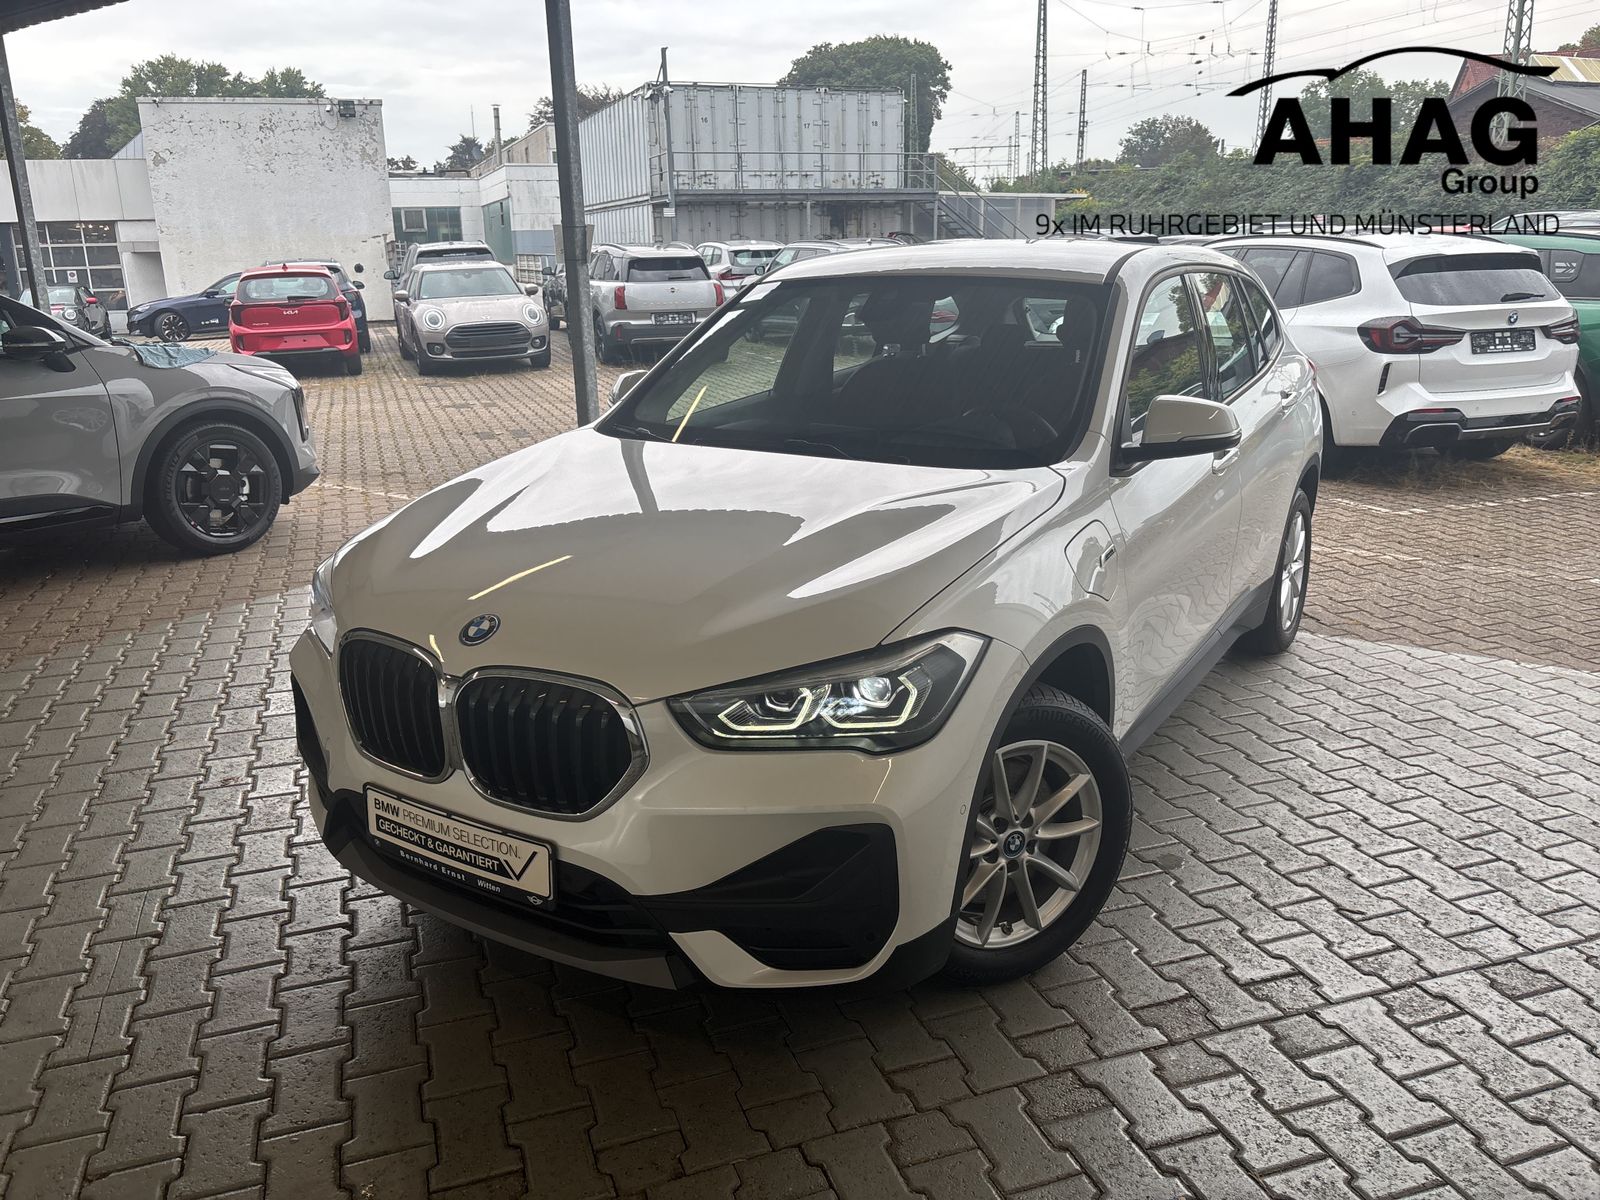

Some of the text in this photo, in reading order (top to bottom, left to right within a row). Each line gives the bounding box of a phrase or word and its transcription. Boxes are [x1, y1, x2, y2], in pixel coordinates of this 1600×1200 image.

[700, 116, 709, 124] 16
[374, 797, 521, 860] BMW PREMIUM SELECTION.
[378, 818, 500, 872] GECHECKT & GARANTIERT
[399, 849, 501, 893] Bernhard Ernst Witten
